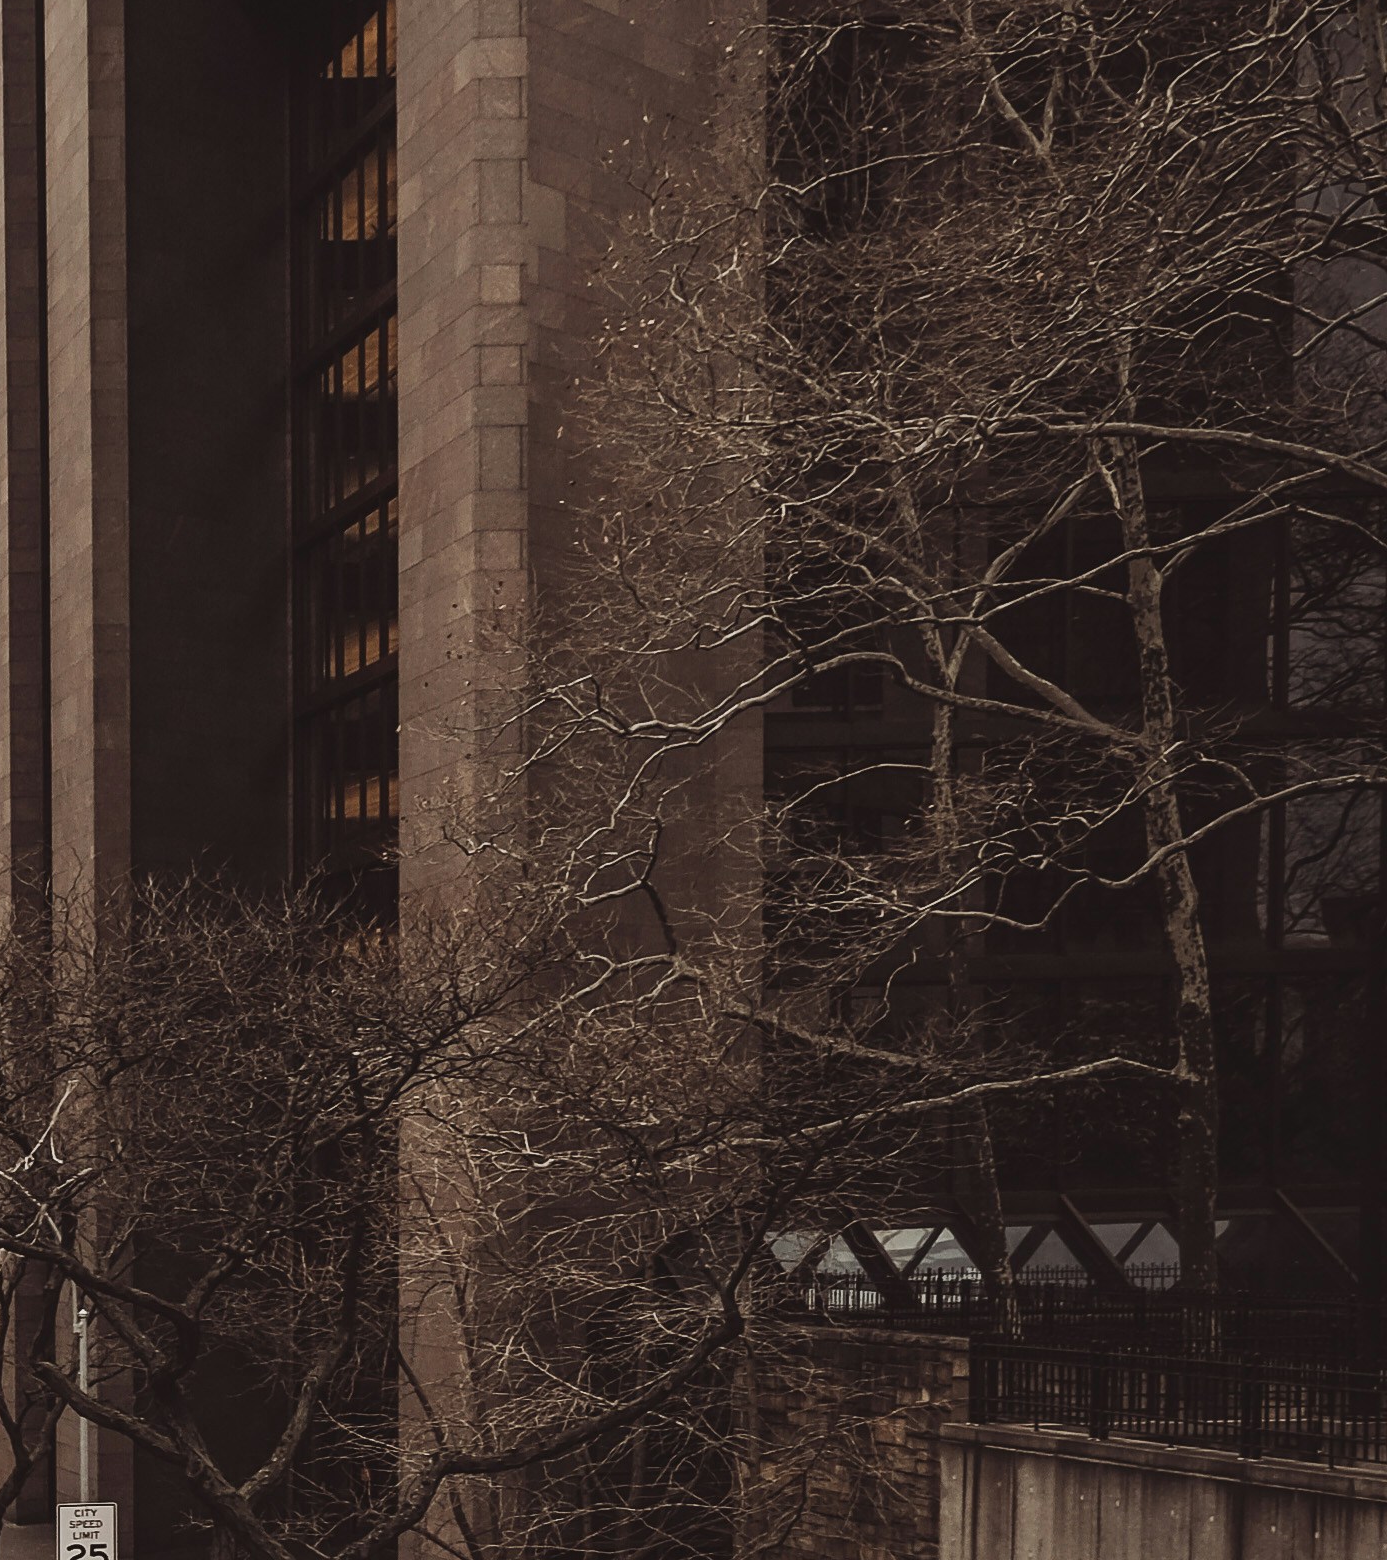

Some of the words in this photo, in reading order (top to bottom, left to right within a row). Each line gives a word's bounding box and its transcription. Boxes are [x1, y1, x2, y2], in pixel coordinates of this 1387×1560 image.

[74, 1508, 98, 1517] CITY
[69, 1519, 103, 1529] SPEED
[73, 1530, 100, 1540] LIMIT
